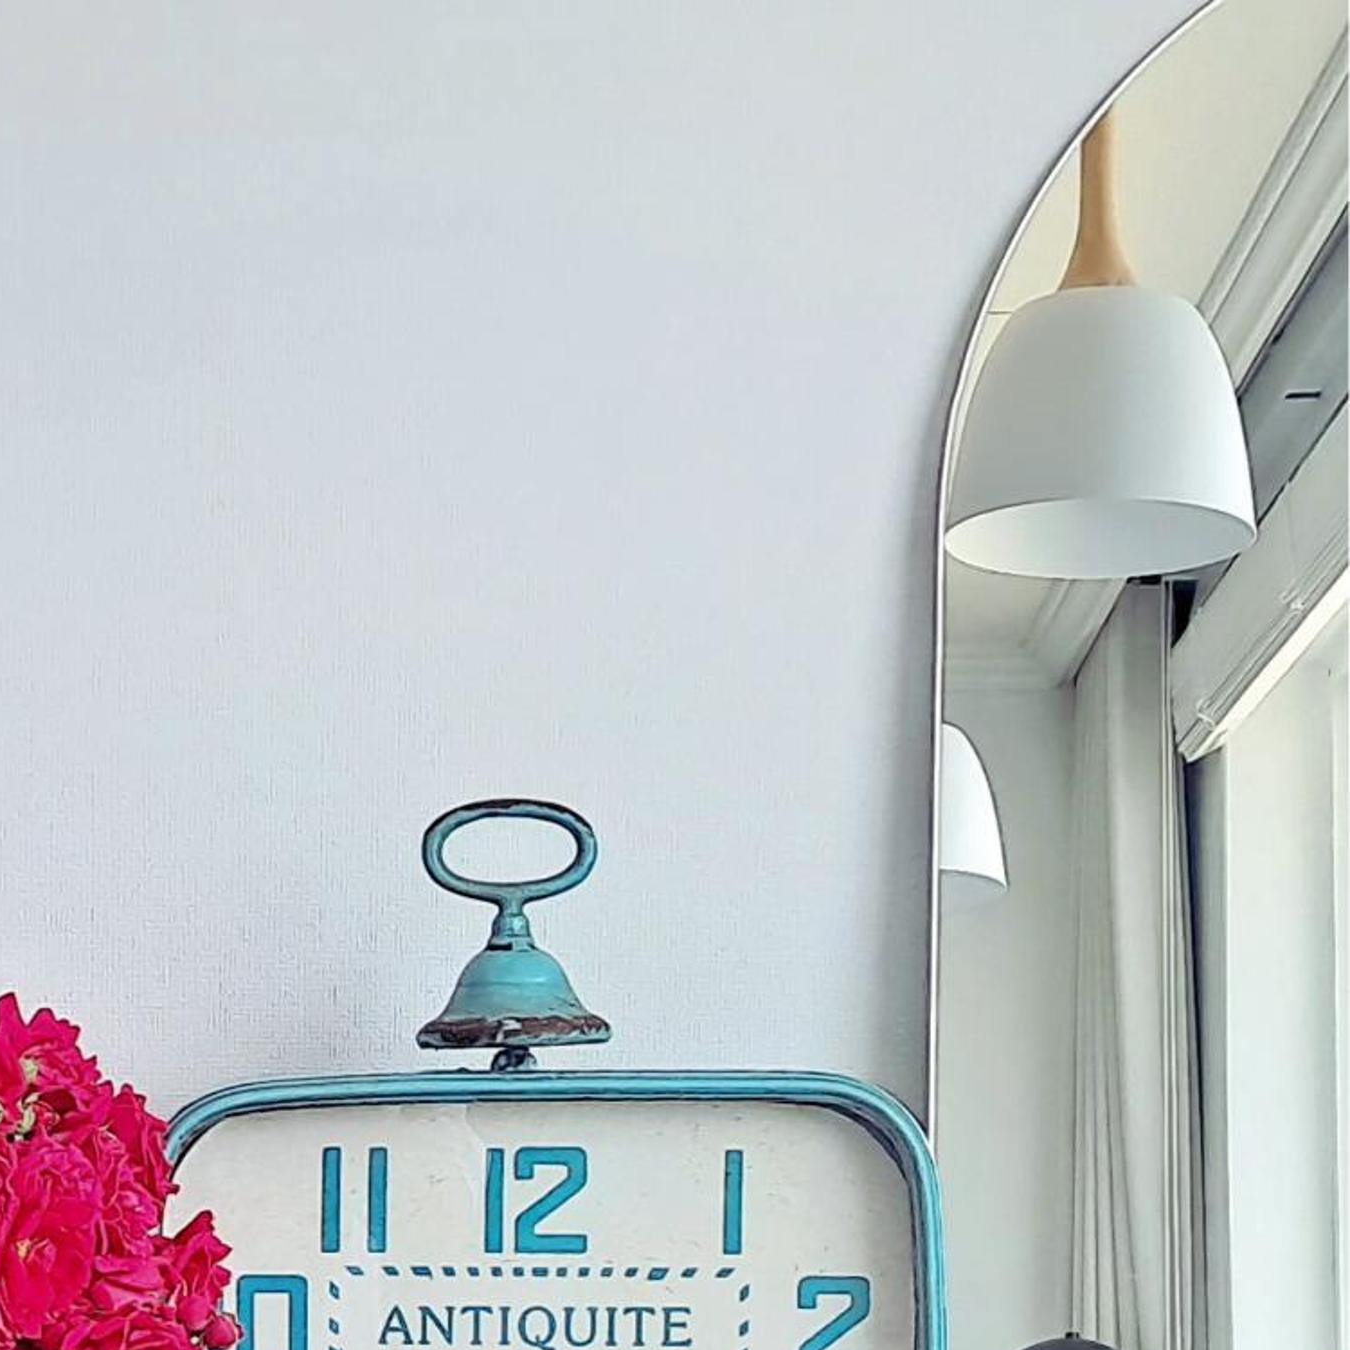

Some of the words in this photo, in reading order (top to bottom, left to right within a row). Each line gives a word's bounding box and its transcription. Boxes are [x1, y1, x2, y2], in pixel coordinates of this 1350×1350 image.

[320, 1145, 388, 1254] 11
[483, 1145, 588, 1255] 12
[722, 1149, 744, 1256] 1
